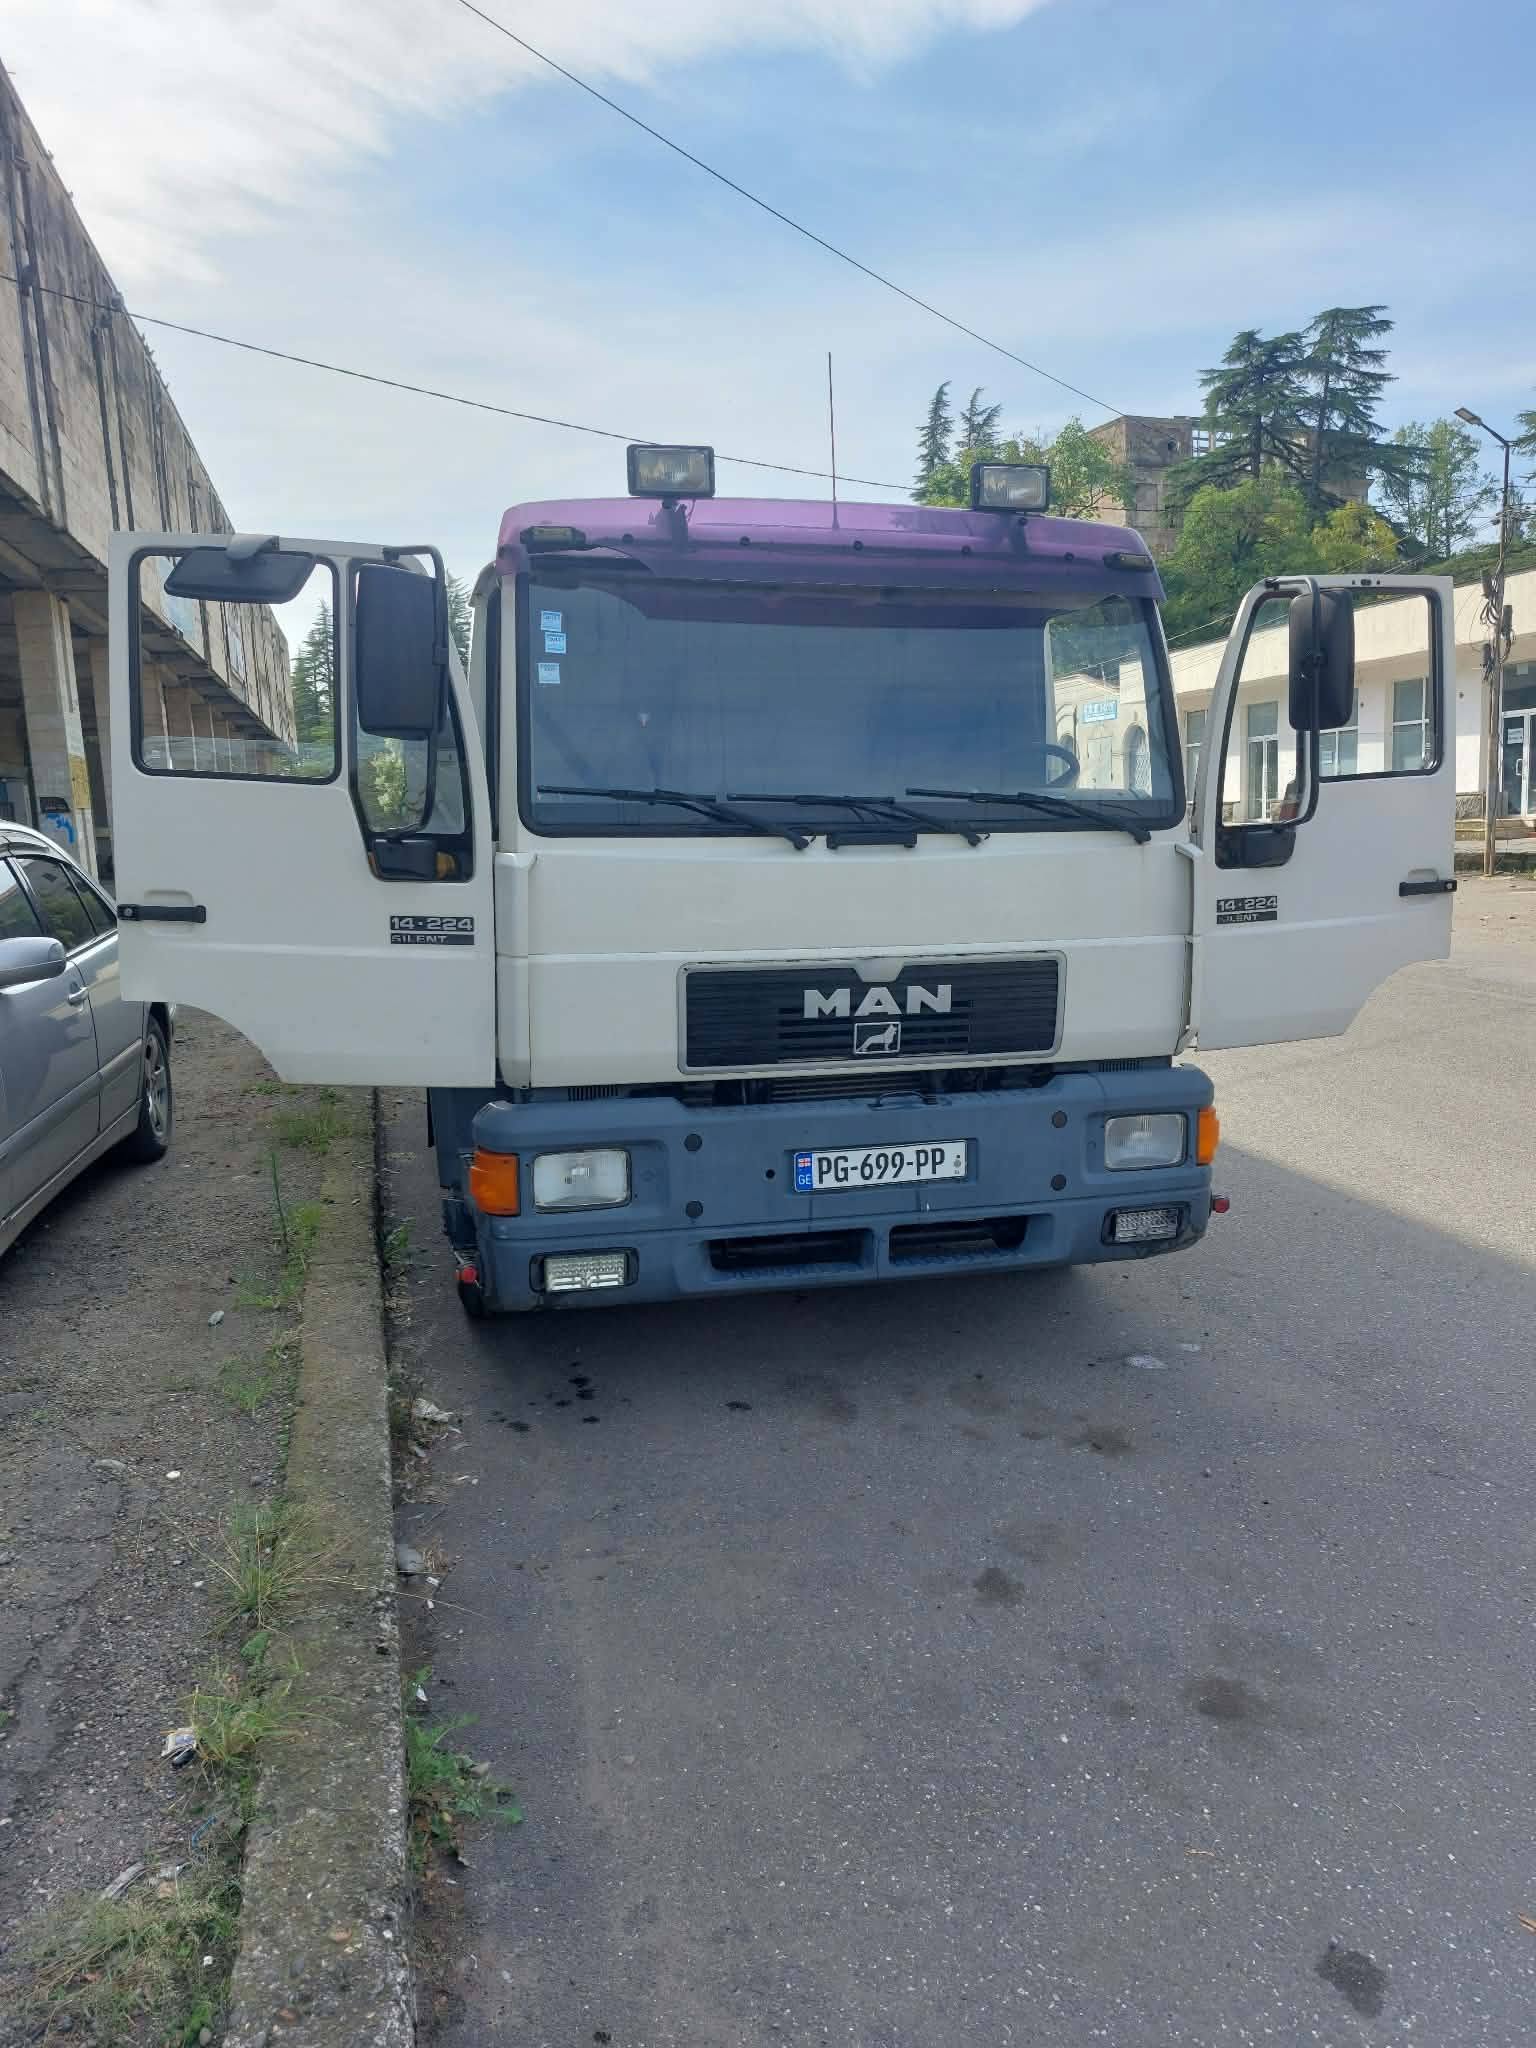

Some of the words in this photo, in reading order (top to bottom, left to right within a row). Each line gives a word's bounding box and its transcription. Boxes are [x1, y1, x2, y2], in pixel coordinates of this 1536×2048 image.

[391, 934, 447, 943] SILENT
[803, 984, 952, 1018] MAN
[817, 1147, 945, 1184] PG-699-PP
[798, 1174, 812, 1185] GE
